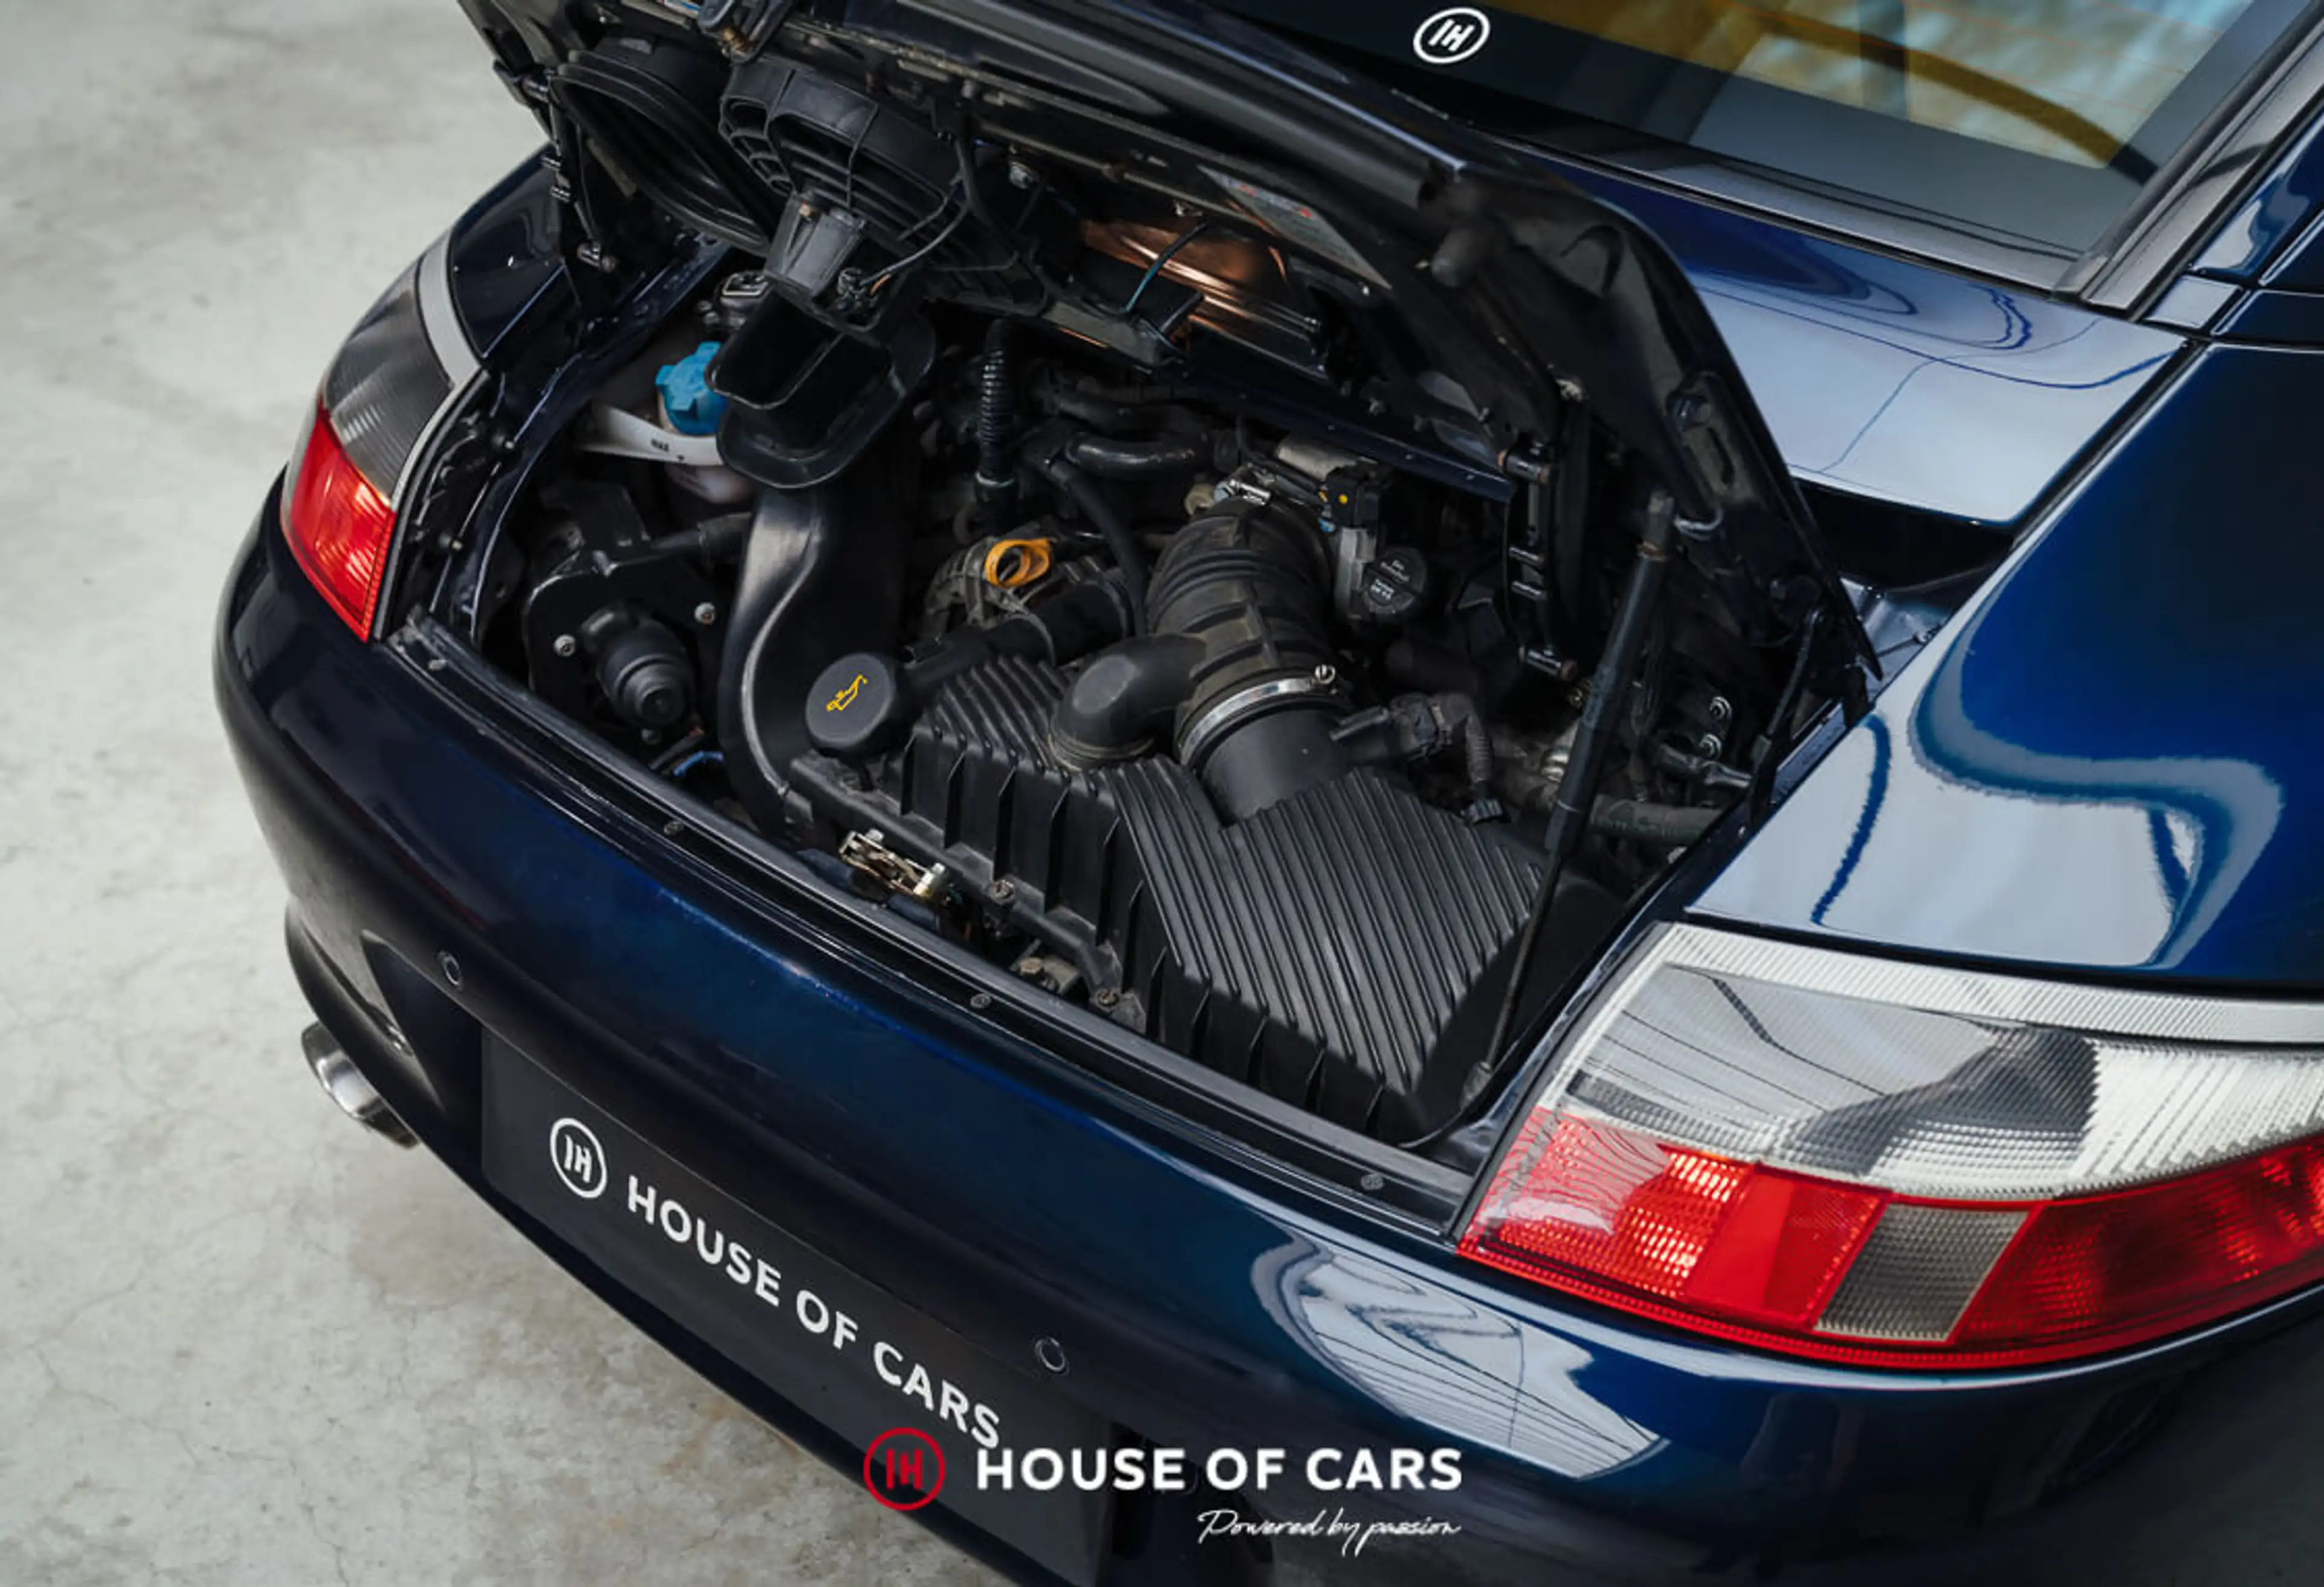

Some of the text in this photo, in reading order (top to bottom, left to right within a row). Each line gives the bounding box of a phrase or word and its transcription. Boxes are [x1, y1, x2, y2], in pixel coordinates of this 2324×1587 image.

[628, 1175, 1000, 1449] HOUSE OF CARS
